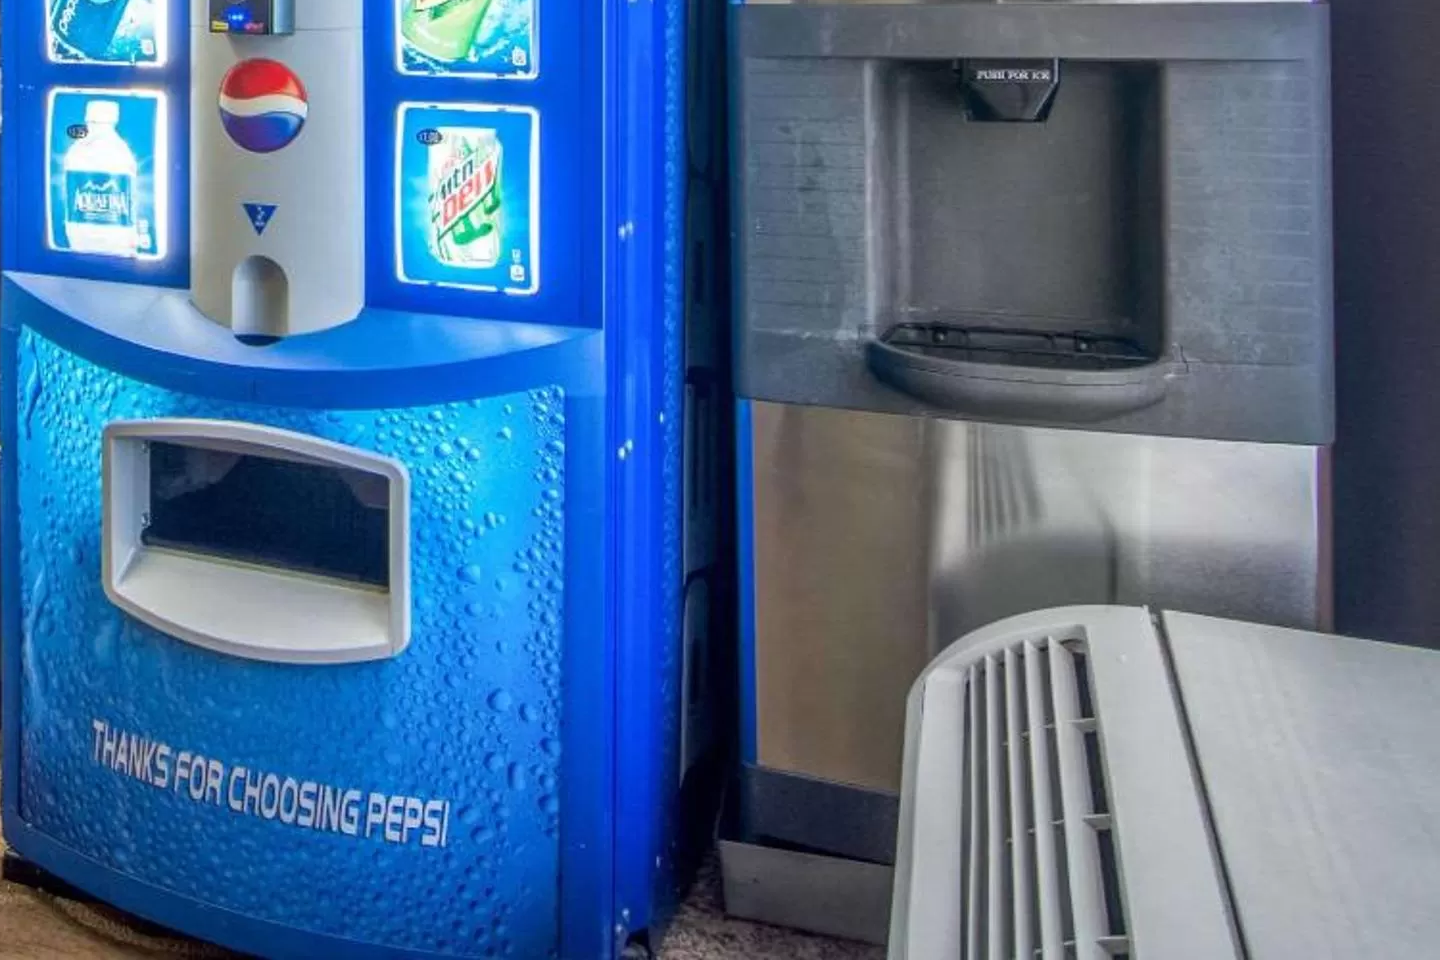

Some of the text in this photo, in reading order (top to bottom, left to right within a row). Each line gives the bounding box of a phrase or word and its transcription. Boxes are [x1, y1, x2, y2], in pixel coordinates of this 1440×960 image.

[92, 718, 451, 848] THANKS FOR CHOOSING PEPSI
